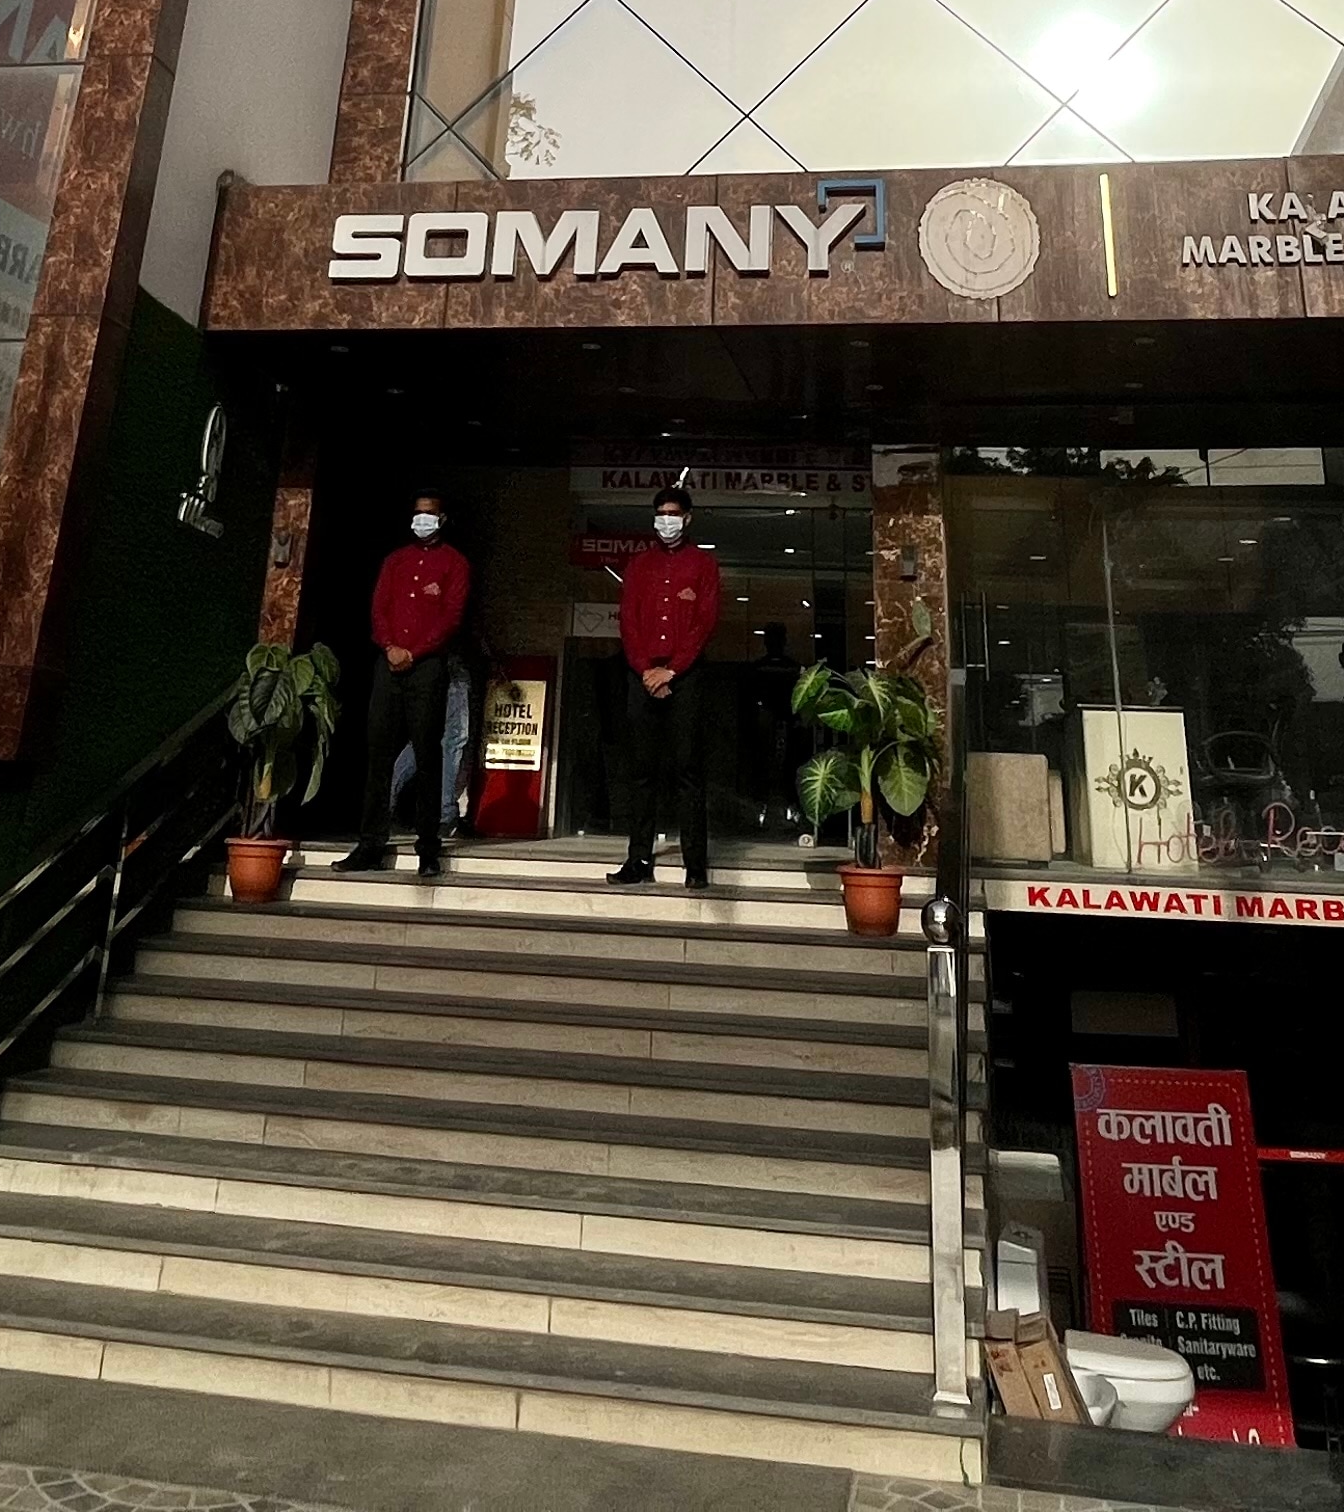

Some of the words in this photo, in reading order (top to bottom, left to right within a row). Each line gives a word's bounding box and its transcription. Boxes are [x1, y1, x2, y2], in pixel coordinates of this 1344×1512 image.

[329, 204, 866, 280] SOMANY
[1182, 233, 1344, 266] MARBLE
[495, 704, 533, 719] HOTEL
[1027, 886, 1223, 917] KALAWATI
[1097, 1102, 1233, 1148] कलावती
[1121, 1155, 1219, 1201] मार्बल
[1154, 1211, 1196, 1234] एण्ड
[1133, 1240, 1226, 1290] स्टील
[1129, 1308, 1159, 1328] Tiles
[1175, 1310, 1199, 1332] C.P.
[1200, 1312, 1240, 1336] Fitting
[1177, 1335, 1257, 1360] Sanitaryware
[1196, 1364, 1221, 1381] etc.
